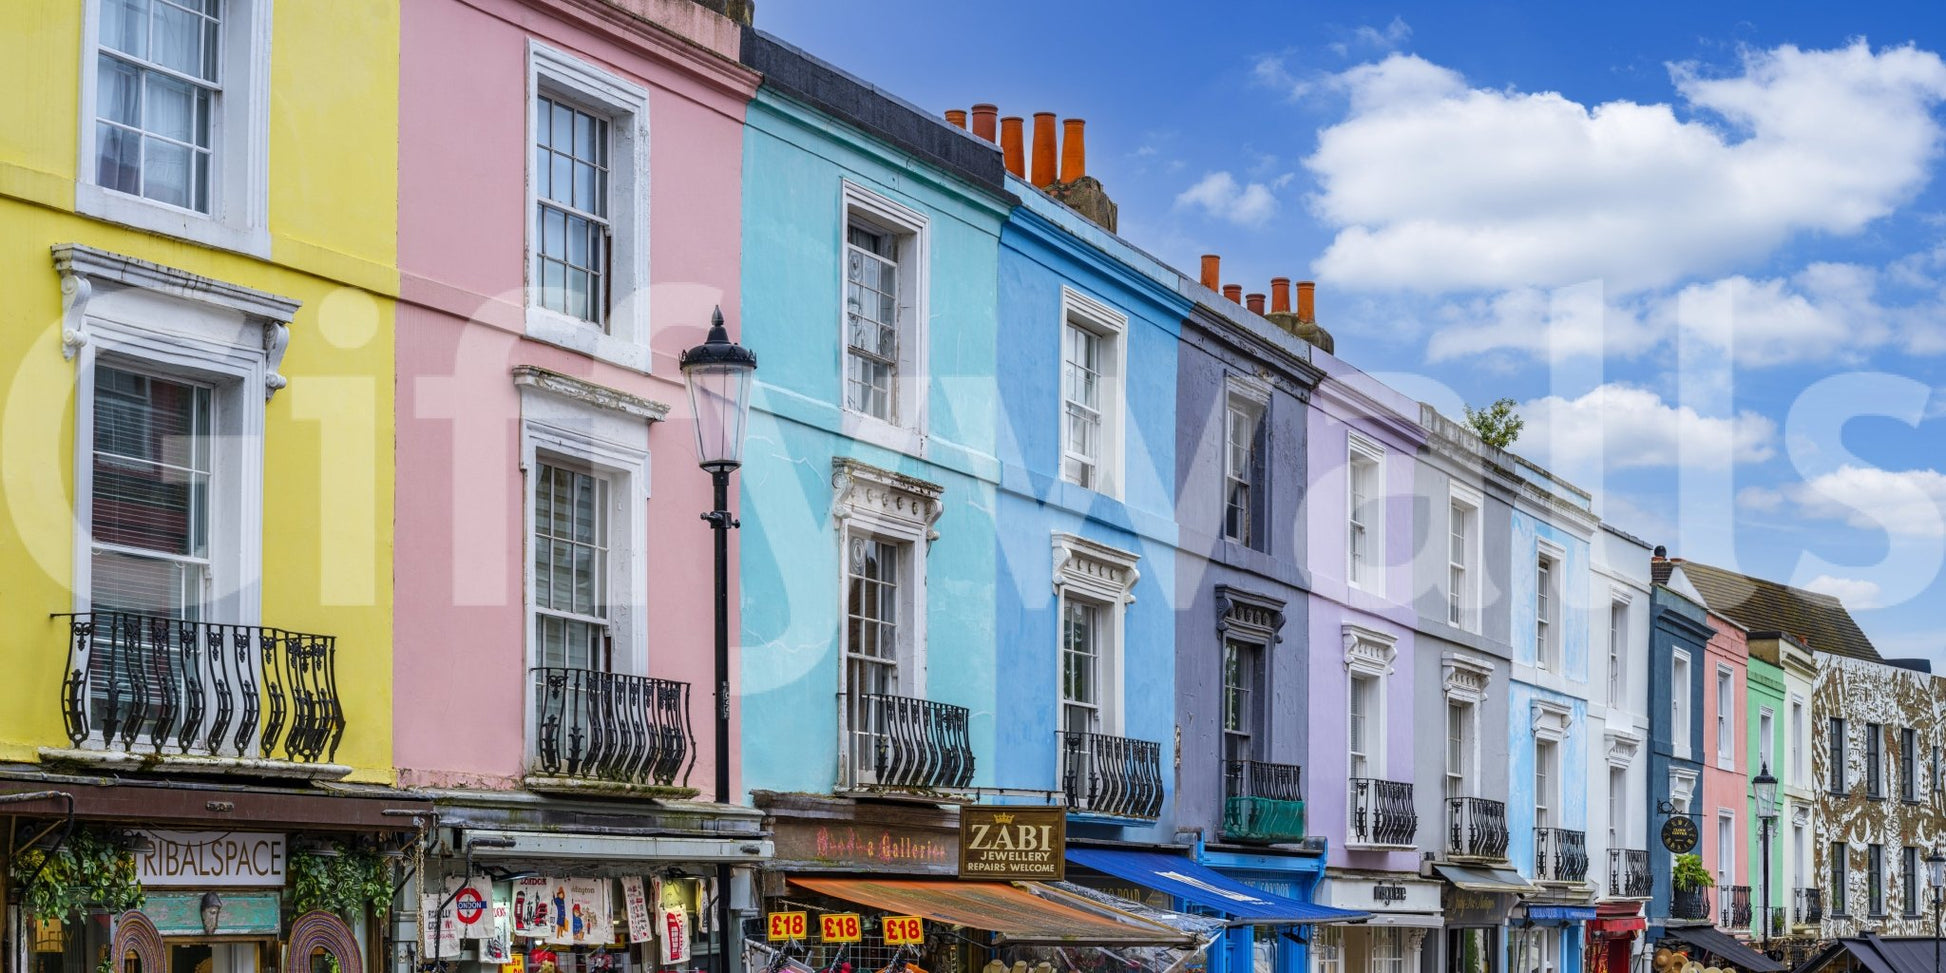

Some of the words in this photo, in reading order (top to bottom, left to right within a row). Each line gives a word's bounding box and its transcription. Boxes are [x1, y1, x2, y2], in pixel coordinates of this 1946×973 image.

[969, 824, 1053, 851] ZABI
[980, 851, 1050, 862] JEWELLERY
[967, 862, 1006, 872] REPAIRS
[1010, 863, 1055, 873] WELCOME
[772, 915, 803, 936] £18
[824, 917, 858, 938] £18
[886, 919, 920, 940] £18
